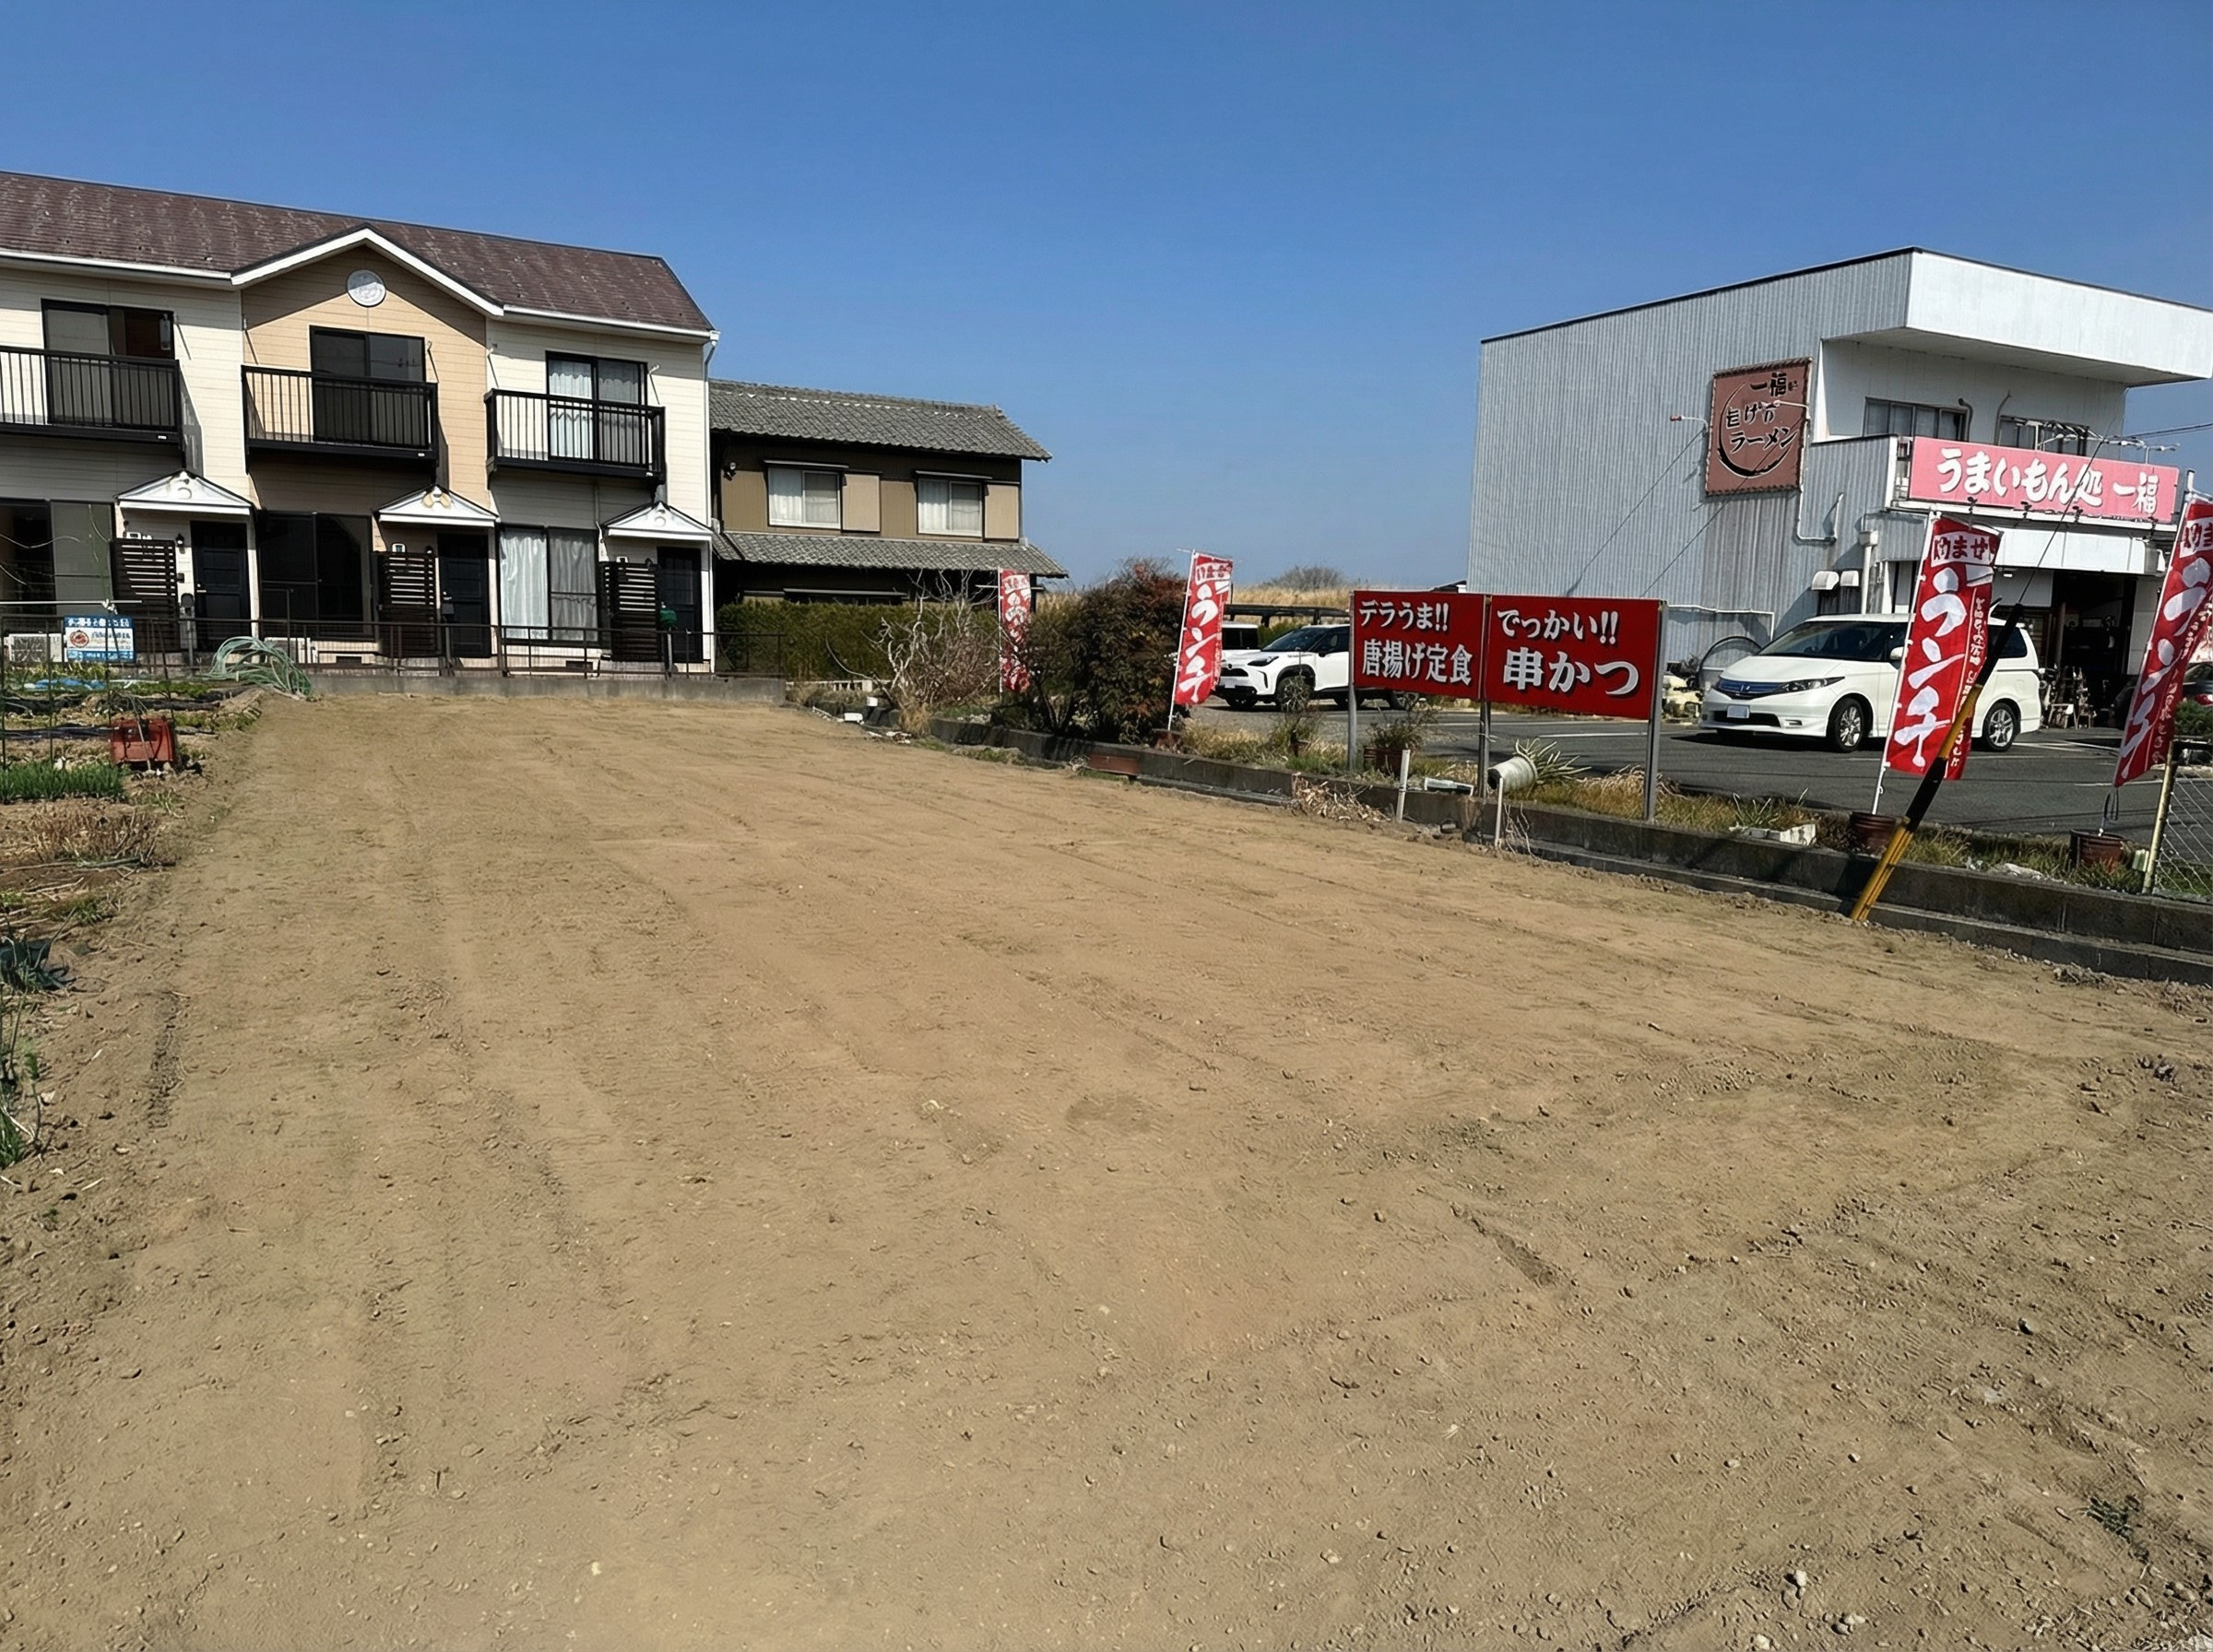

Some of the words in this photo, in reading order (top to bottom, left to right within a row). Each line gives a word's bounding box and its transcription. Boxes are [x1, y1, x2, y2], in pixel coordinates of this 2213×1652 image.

[1729, 427, 1797, 454] ラーメン
[1936, 447, 2103, 507] うまいもん処
[2112, 471, 2160, 514] 一福
[1497, 608, 1619, 644] でっかい!!
[1362, 638, 1473, 686] 唐揚げ定食
[1503, 647, 1640, 695] 串かつ
